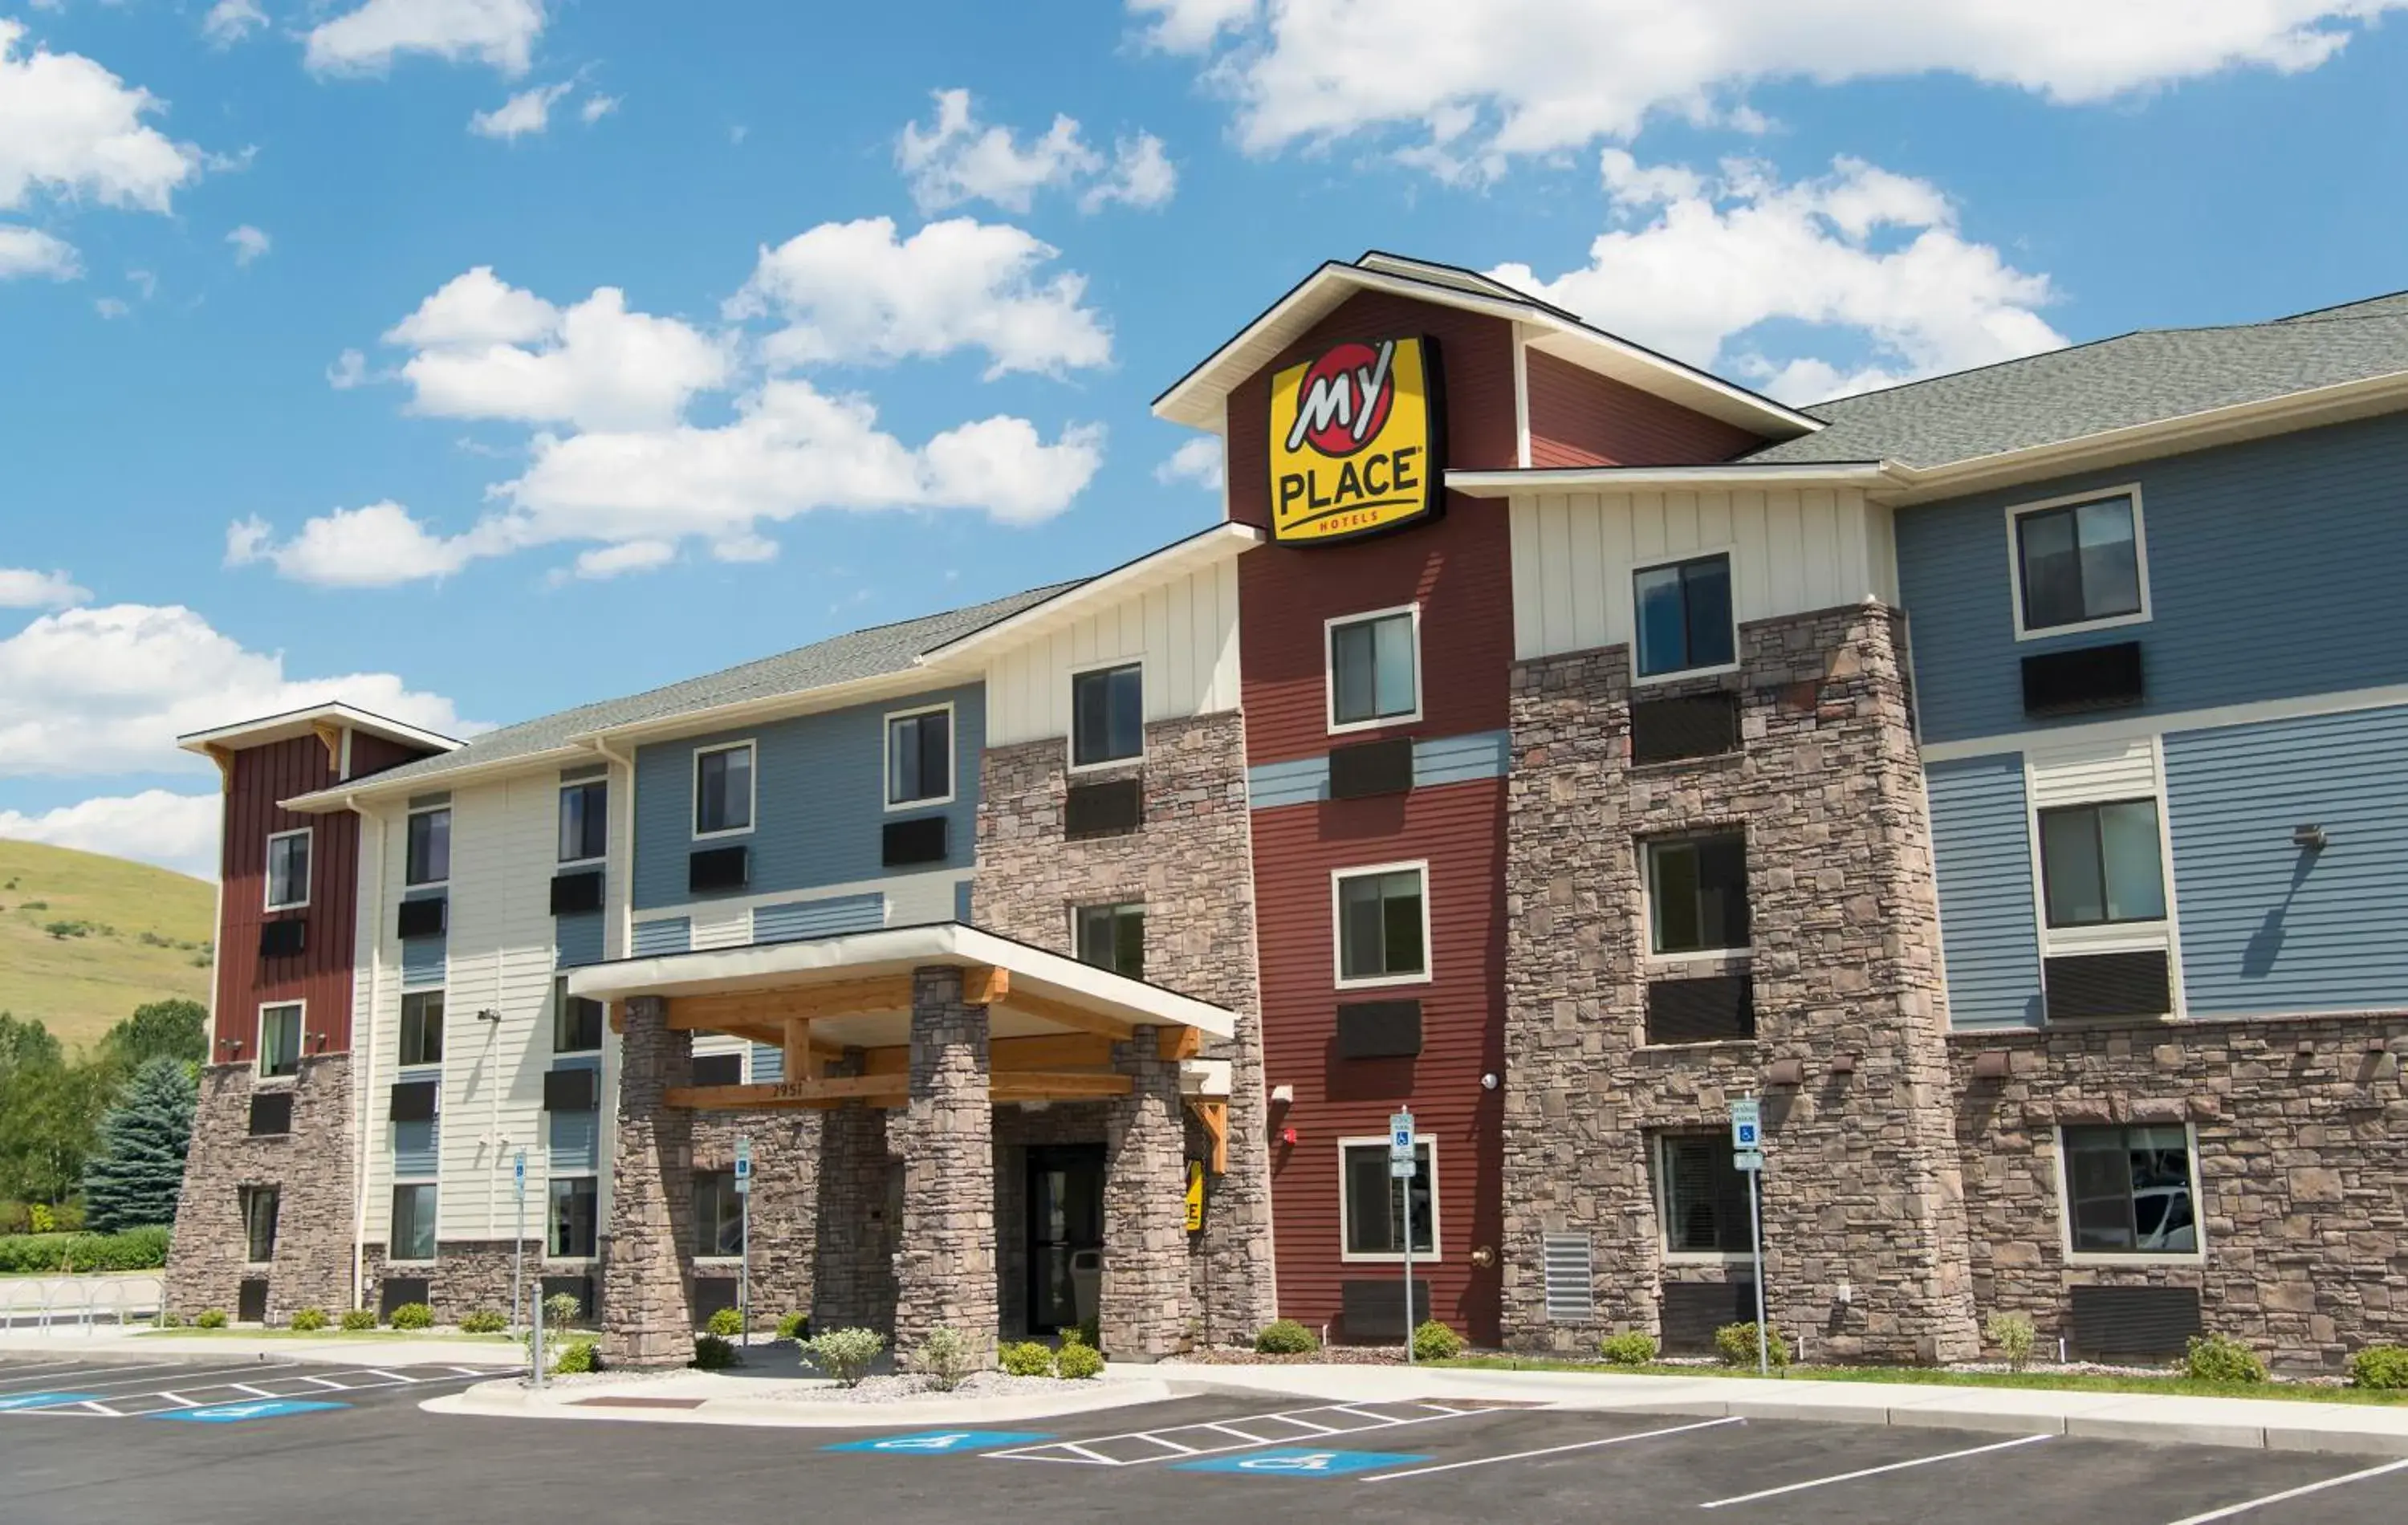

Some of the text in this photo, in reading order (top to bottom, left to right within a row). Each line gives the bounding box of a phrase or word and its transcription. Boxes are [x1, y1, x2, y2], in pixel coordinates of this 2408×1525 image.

[1279, 446, 1418, 515] PLACE
[1320, 510, 1378, 533] HOTELS
[771, 1083, 802, 1097] 2951
